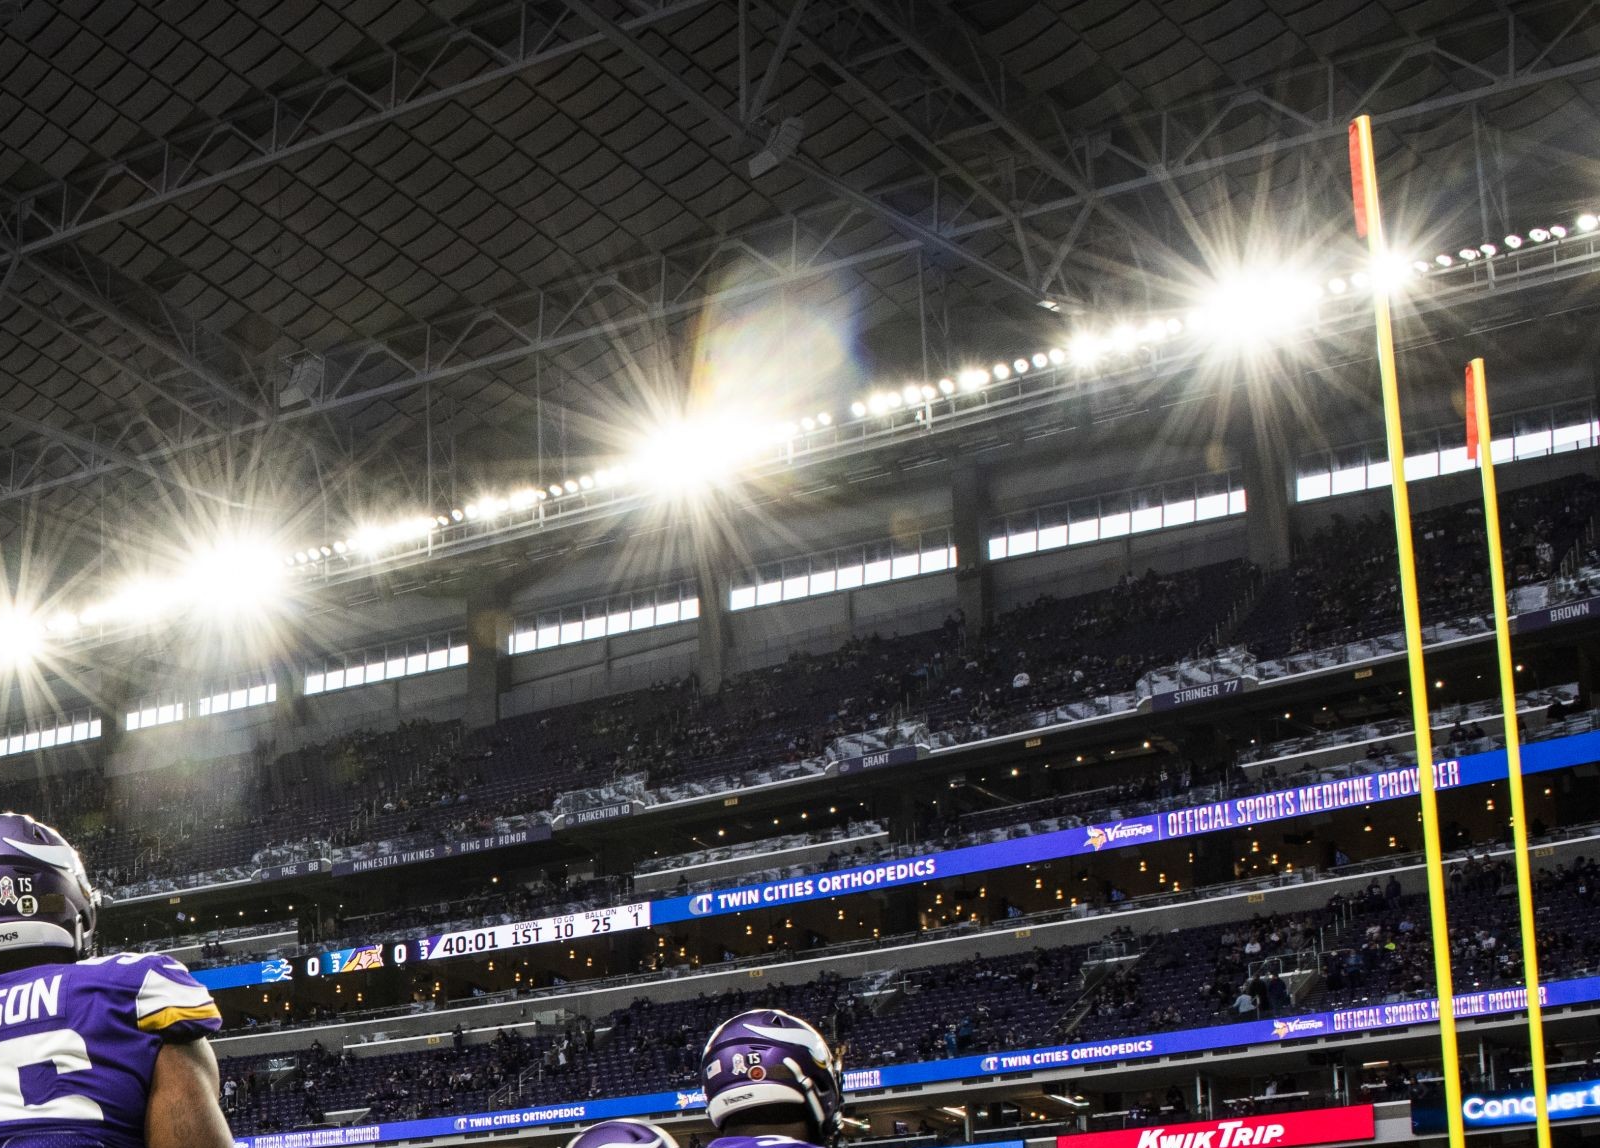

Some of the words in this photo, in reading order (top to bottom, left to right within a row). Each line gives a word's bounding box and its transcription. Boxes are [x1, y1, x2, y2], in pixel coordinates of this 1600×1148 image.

[1550, 602, 1590, 622] BROWN
[1174, 685, 1219, 704] STRINGER
[1223, 679, 1238, 692] 77
[862, 753, 889, 769] GRANT
[577, 807, 618, 824] TARKENTON
[620, 804, 630, 815] 10
[1167, 804, 1232, 837] OFFICIAL
[1236, 791, 1295, 825] SPORTS
[1298, 776, 1374, 813] MEDICINE
[353, 855, 398, 872] MINNESOTA
[402, 848, 435, 864] VIKINGS
[460, 839, 481, 853] RING
[484, 837, 495, 848] OF
[498, 831, 527, 846] HONOR
[281, 865, 297, 877] PAGE
[308, 861, 319, 872] 88
[17, 878, 32, 892] TS
[717, 889, 759, 910] TWIN
[763, 878, 813, 902] CITIES
[818, 859, 936, 893] ORTHOPEDICS
[585, 911, 603, 921] BALL
[604, 908, 617, 918] ON
[628, 903, 644, 914] QTR
[514, 920, 539, 931] DOWN
[553, 916, 563, 925] TO
[564, 915, 575, 924] GO
[591, 917, 611, 934] 25
[633, 912, 640, 927] 1
[511, 927, 542, 946] 1ST
[554, 923, 574, 940] 10
[443, 932, 498, 955] 40:01
[394, 944, 406, 964] 0
[420, 946, 429, 960] 3
[307, 958, 320, 977] 0
[331, 960, 340, 973] 3
[1333, 1007, 1382, 1031] OFFICIAL
[1385, 1002, 1429, 1025] SPORTS
[1001, 1055, 1031, 1068] TWIN
[1033, 1050, 1068, 1064] CITIES
[1071, 1039, 1153, 1060] ORTHOPEDICS
[469, 1116, 490, 1128] TWIN
[493, 1113, 521, 1126] CITIES
[522, 1106, 585, 1123] ORTHOPEDICS
[284, 1133, 310, 1148] SPORTS
[312, 1130, 347, 1147] MEDICINE
[349, 1126, 380, 1143] PROVIDER
